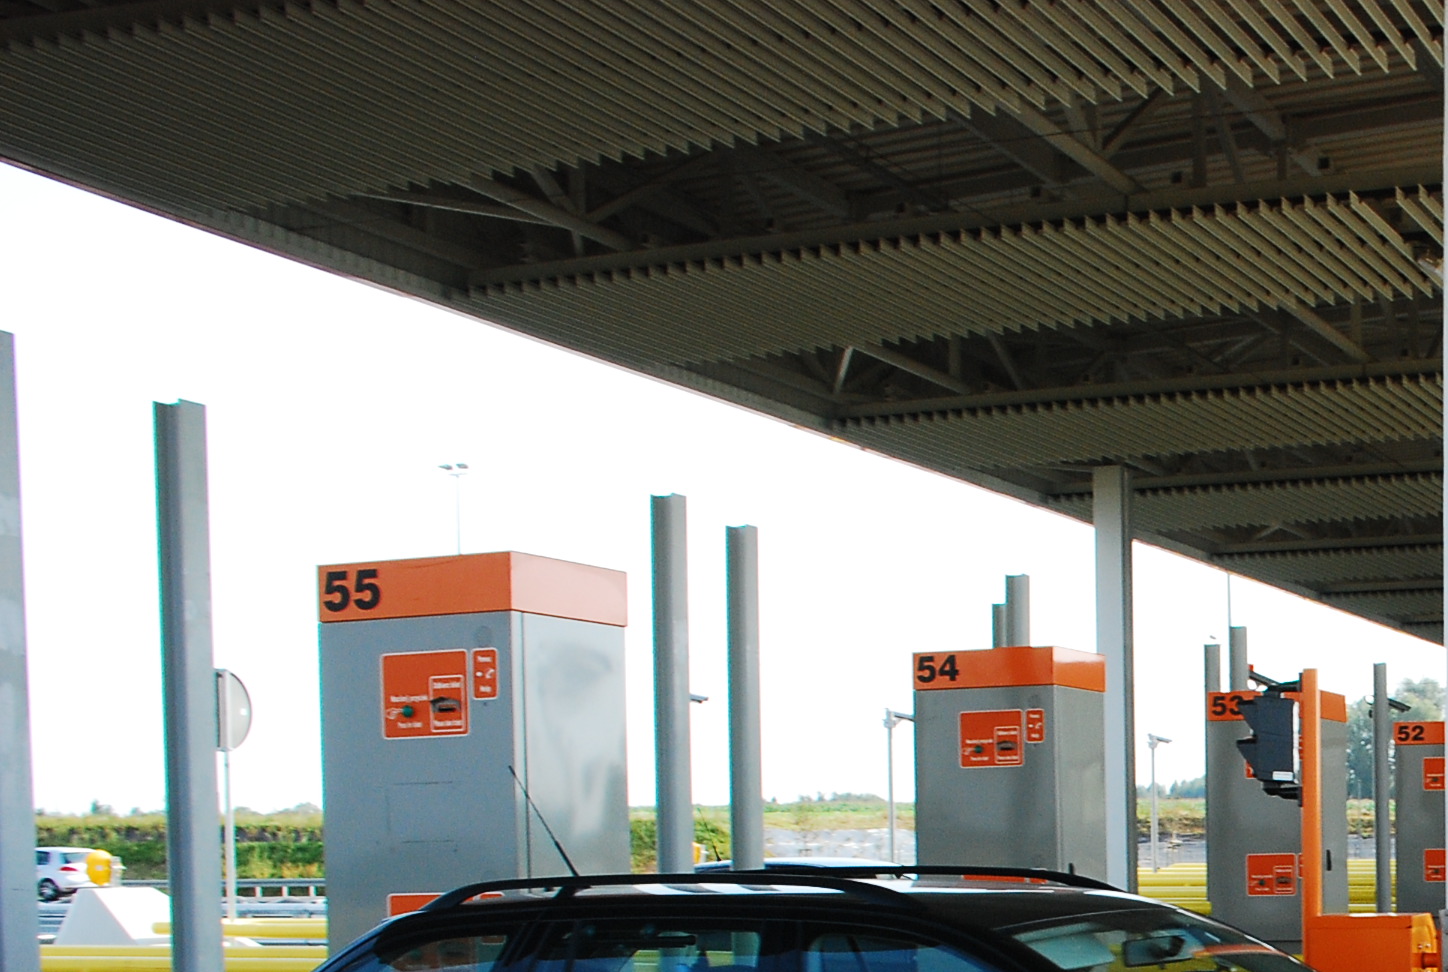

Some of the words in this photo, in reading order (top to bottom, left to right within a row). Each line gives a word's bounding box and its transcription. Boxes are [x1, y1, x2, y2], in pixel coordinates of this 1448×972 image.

[323, 568, 381, 612] 55
[916, 654, 960, 684] 54
[1211, 695, 1244, 716] 53
[1397, 725, 1425, 741] 52
